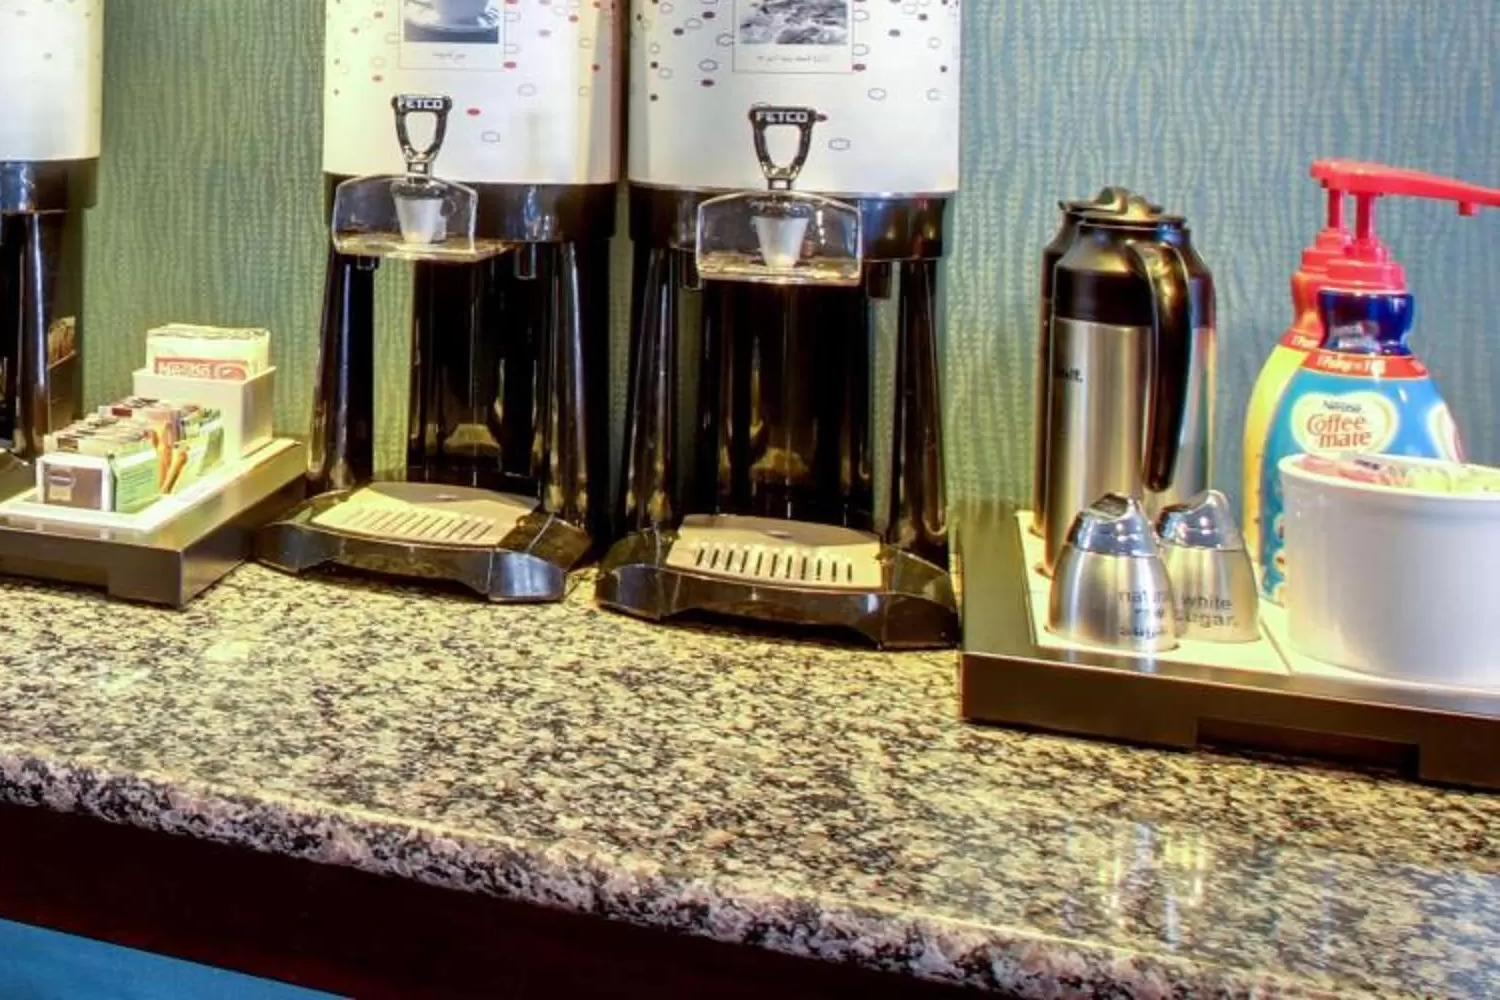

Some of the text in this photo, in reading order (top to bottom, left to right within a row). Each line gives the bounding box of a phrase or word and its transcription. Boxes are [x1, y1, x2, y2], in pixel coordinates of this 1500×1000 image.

[397, 98, 444, 110] FETCO
[755, 111, 809, 123] FETCO
[1319, 431, 1373, 449] mate
